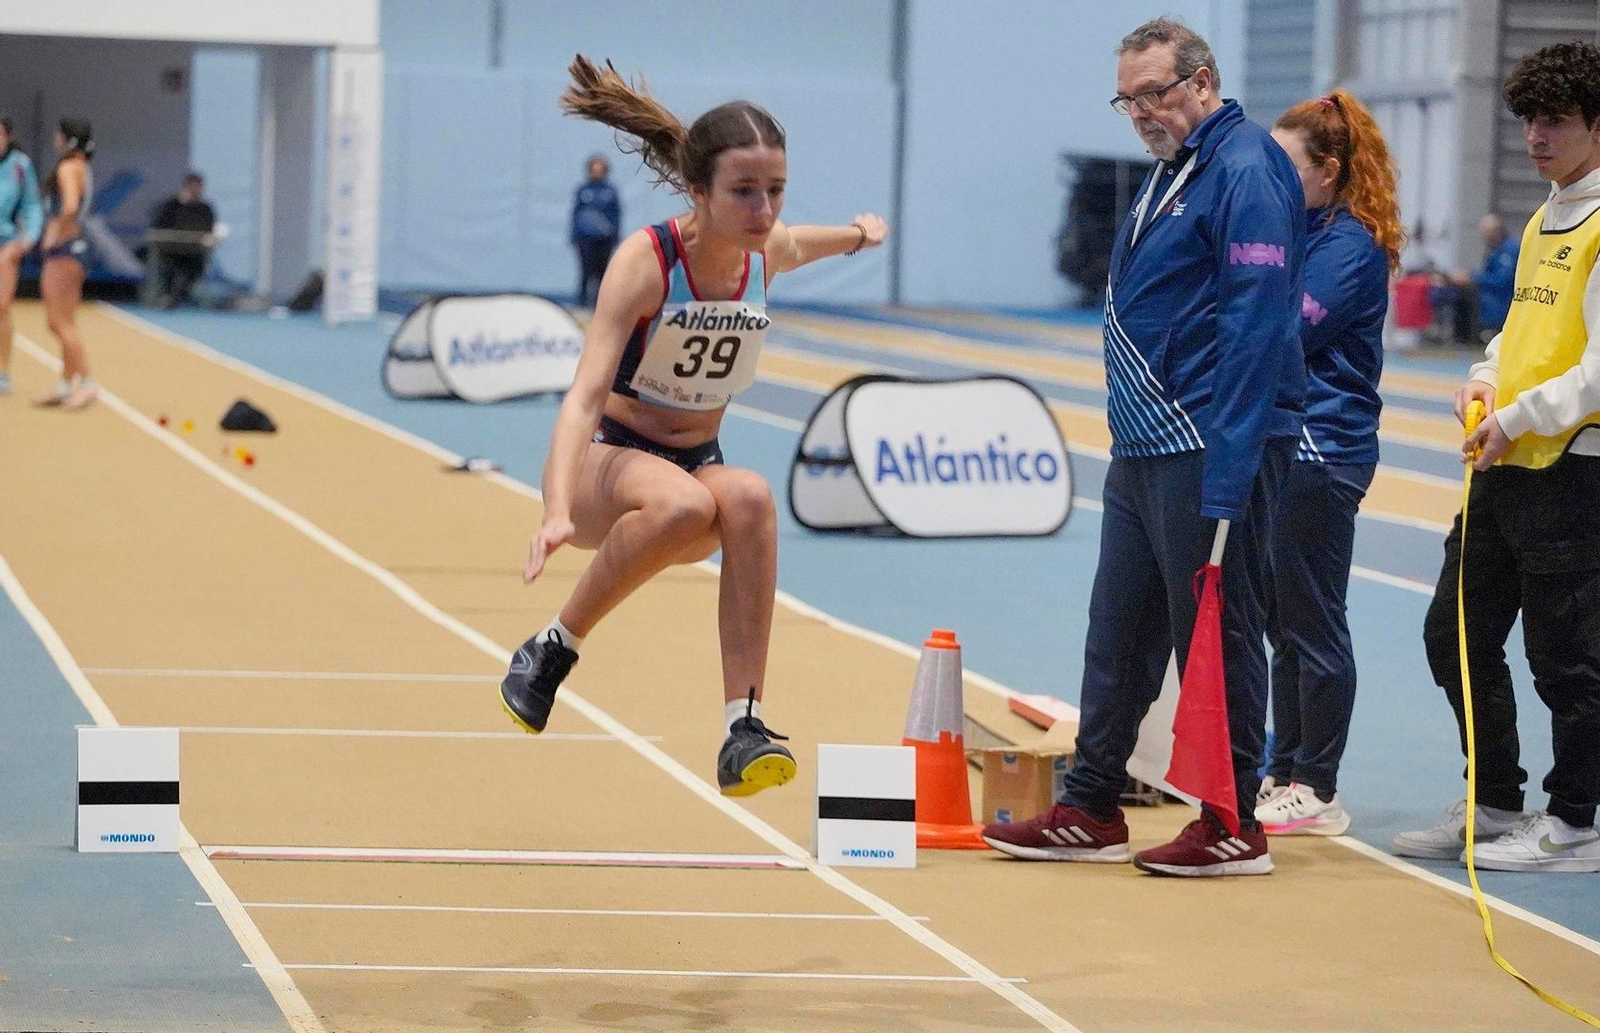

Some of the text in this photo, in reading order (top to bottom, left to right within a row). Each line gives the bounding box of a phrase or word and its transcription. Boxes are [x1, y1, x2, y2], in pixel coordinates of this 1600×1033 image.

[665, 307, 771, 331] Atlántico
[673, 335, 742, 379] 39
[875, 435, 1058, 484] Atlántico
[109, 833, 156, 843] MONDO
[850, 848, 895, 859] MONDO
